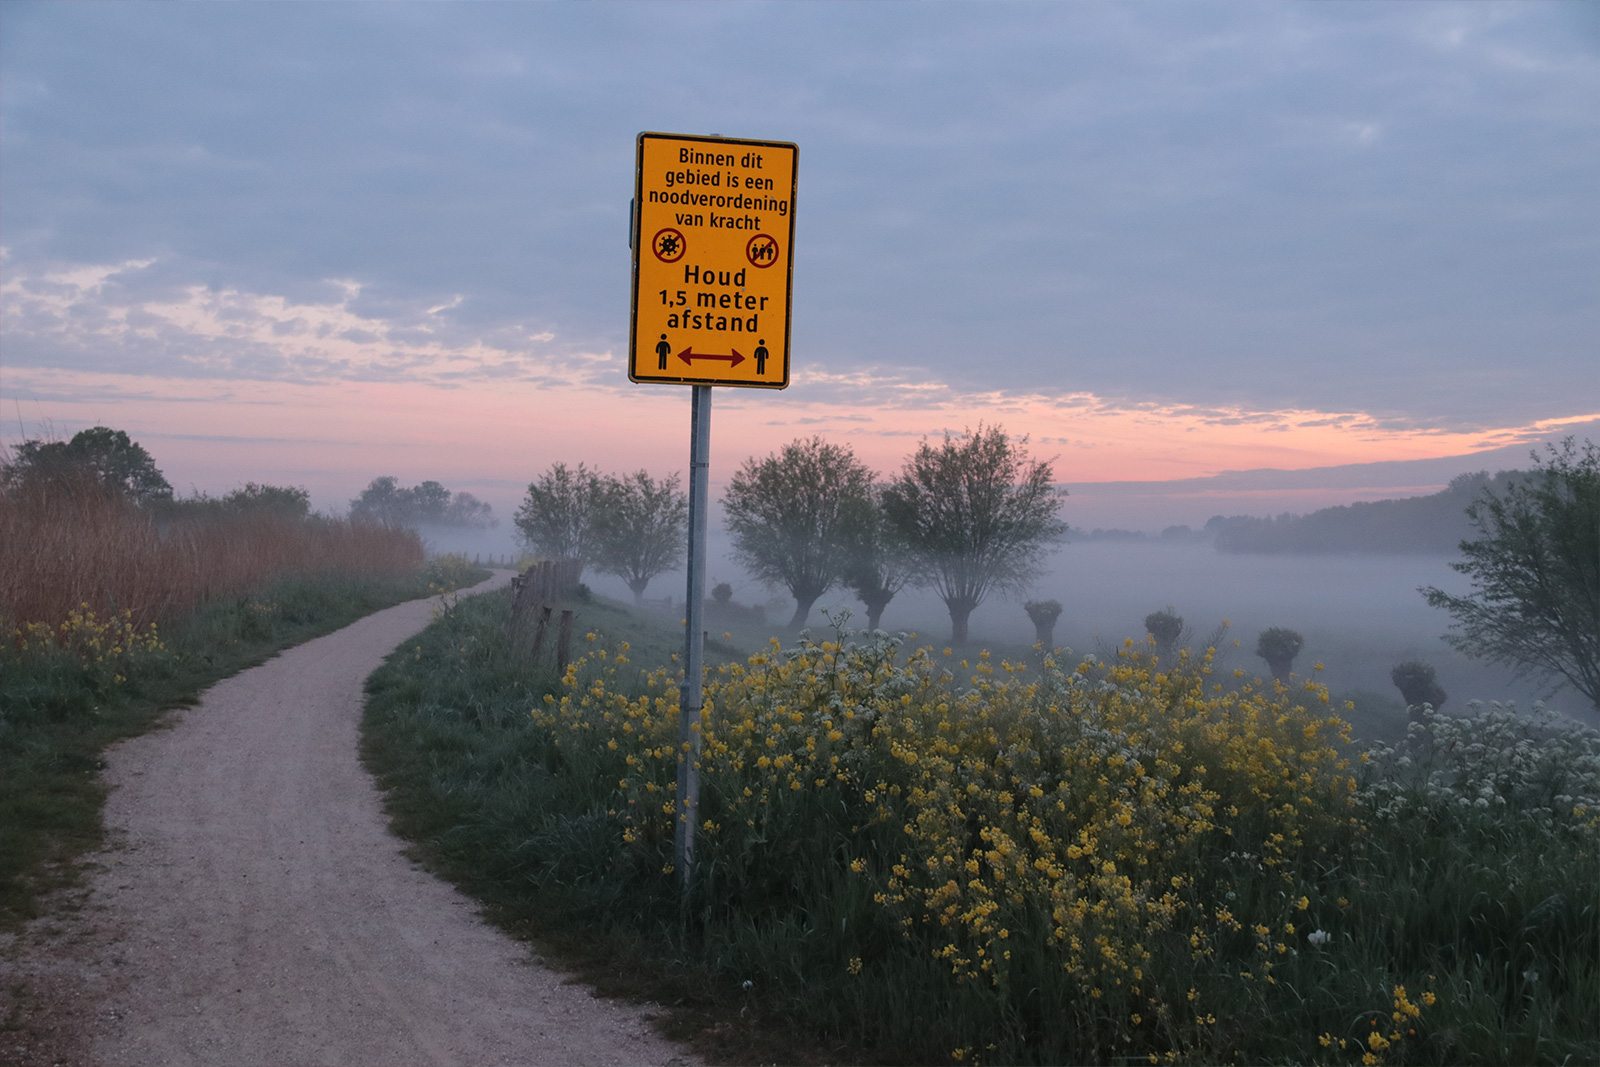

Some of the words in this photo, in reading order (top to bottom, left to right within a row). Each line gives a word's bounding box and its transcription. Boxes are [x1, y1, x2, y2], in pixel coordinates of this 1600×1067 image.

[679, 148, 735, 167] Binnen
[741, 153, 763, 169] dit
[665, 169, 720, 187] gebied
[726, 171, 739, 188] is
[745, 177, 773, 190] een
[649, 190, 788, 216] noodverordening
[675, 213, 703, 226] van
[710, 212, 761, 230] kracht
[684, 265, 746, 287] Houd
[659, 289, 687, 308] 1,5
[697, 291, 769, 311] meter
[667, 309, 758, 333] afstand
